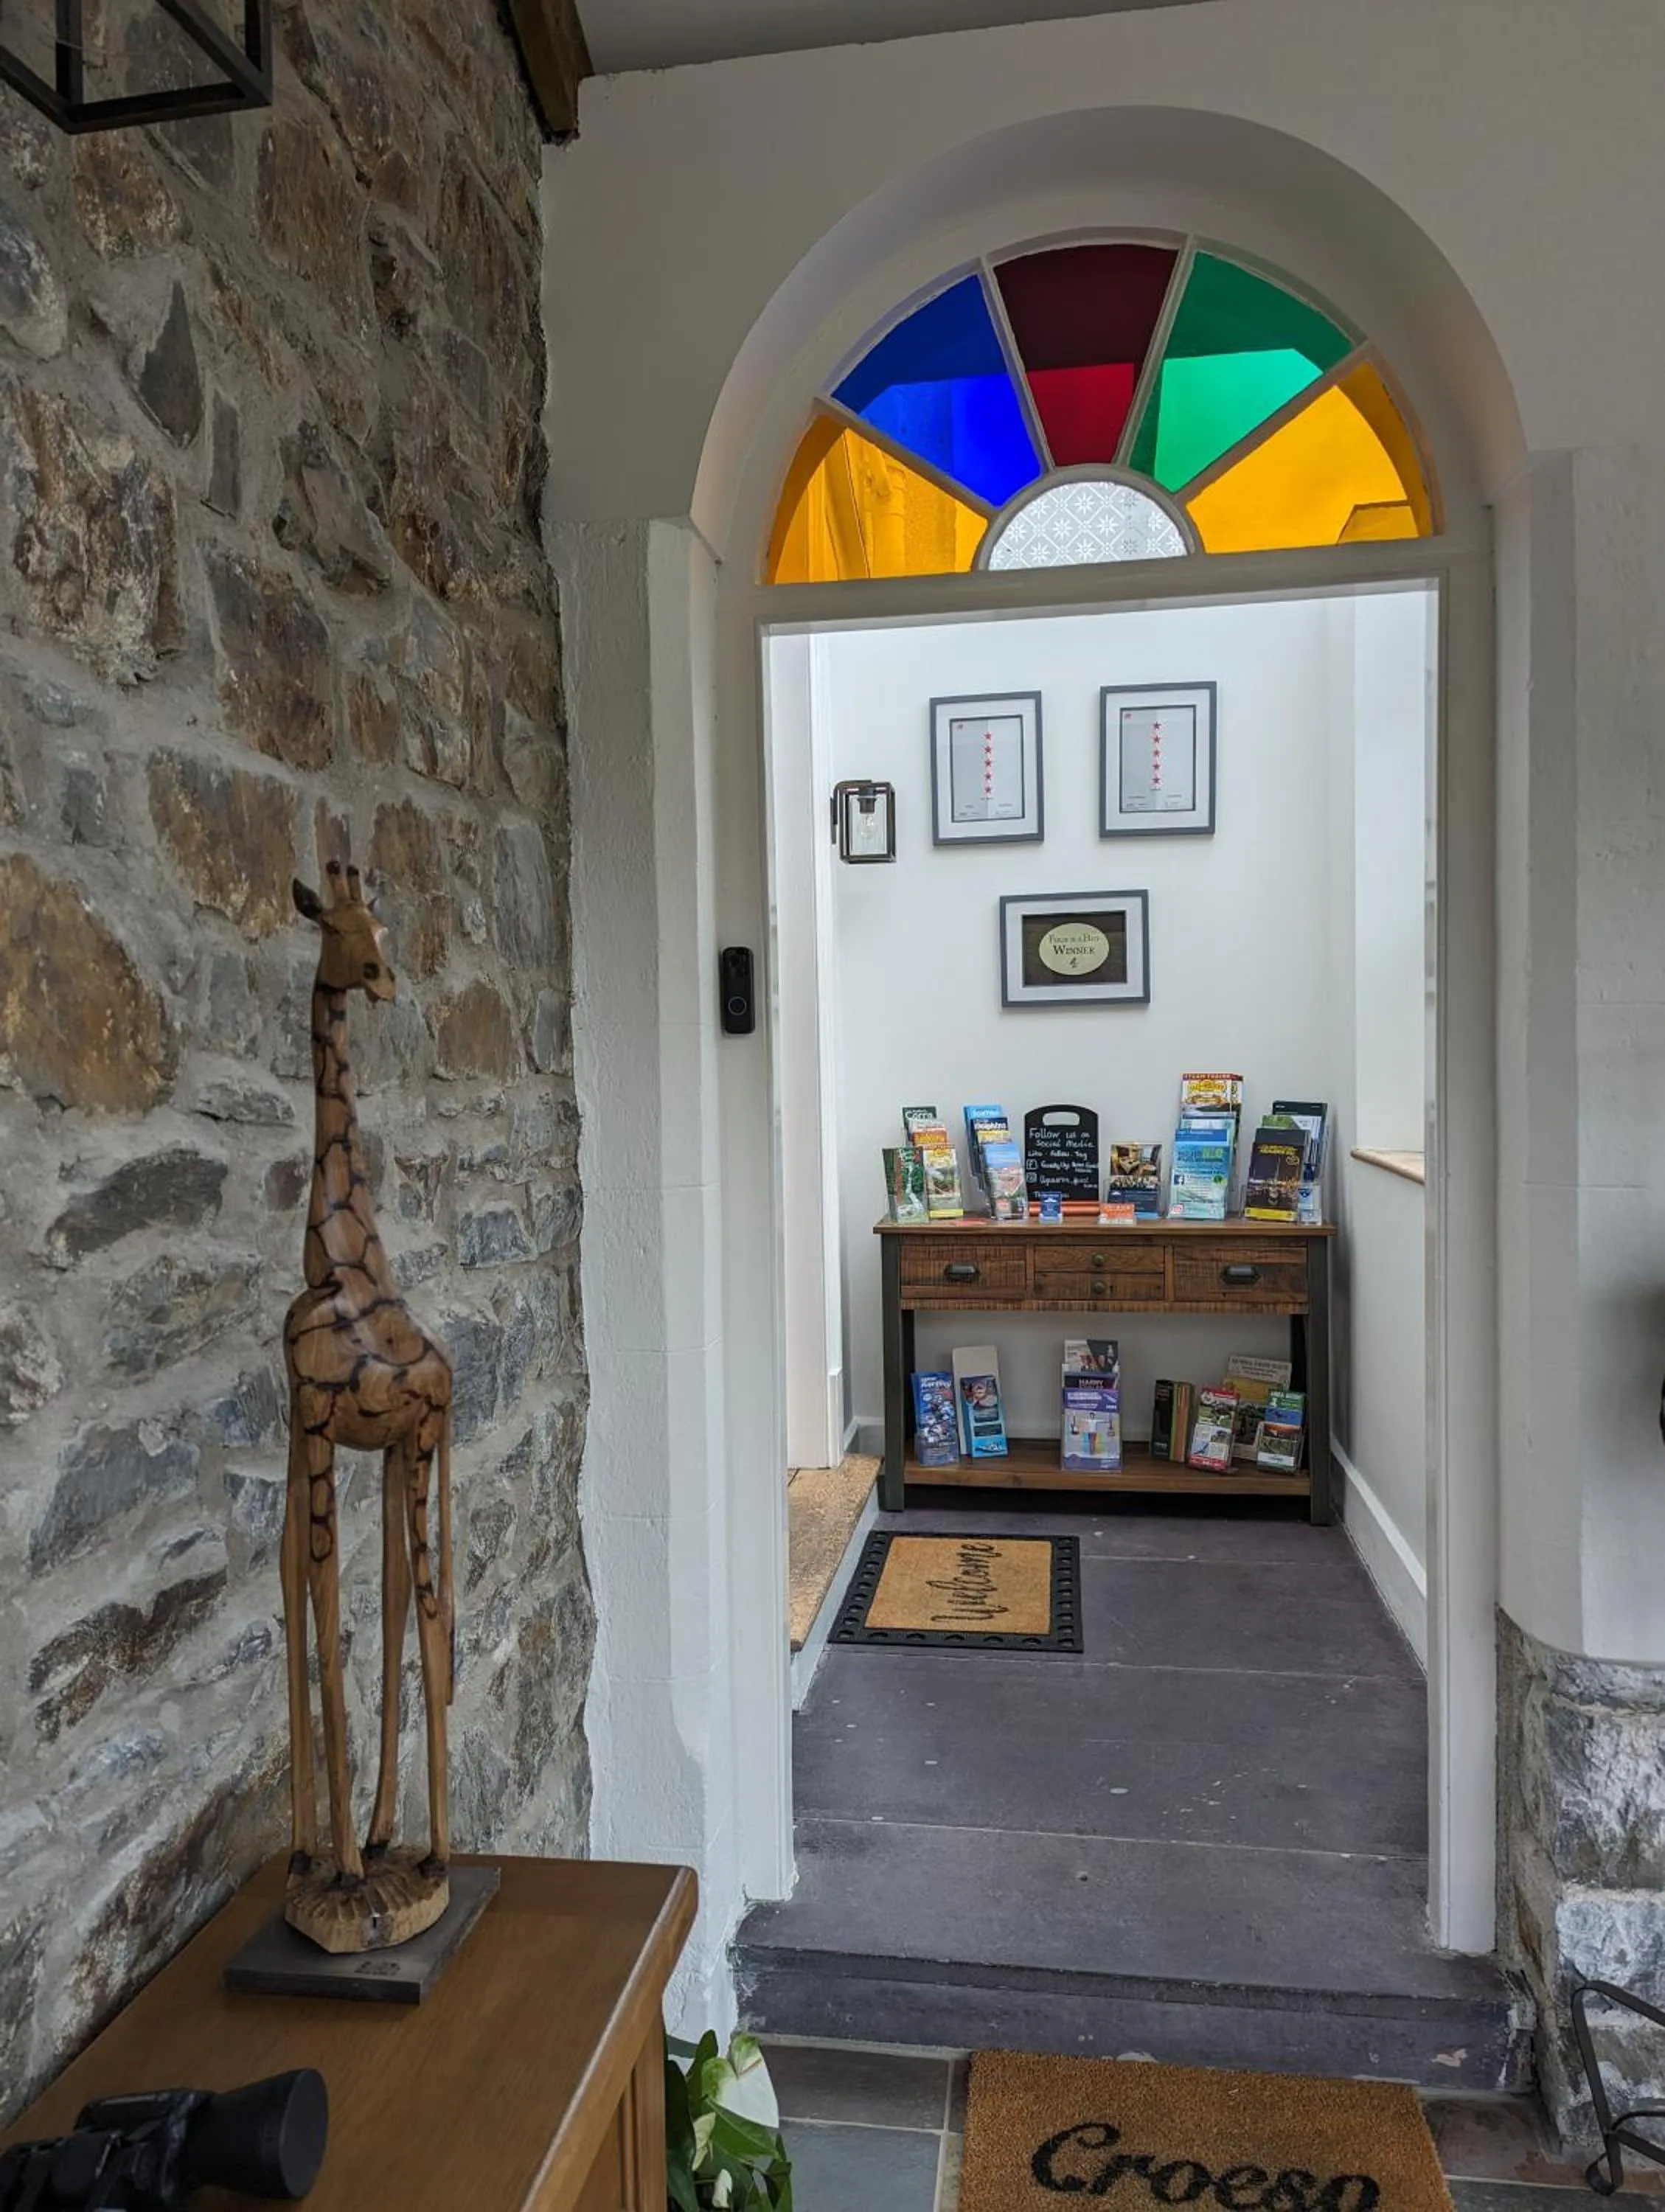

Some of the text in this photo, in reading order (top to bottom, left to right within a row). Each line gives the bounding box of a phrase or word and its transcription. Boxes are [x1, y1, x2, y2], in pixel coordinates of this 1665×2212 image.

[1053, 945, 1095, 955] WINNER
[1029, 1127, 1060, 1138] Follow
[1035, 1138, 1095, 1147] Social Media
[925, 1542, 1009, 1622] Welcome
[1032, 2122, 1381, 2212] Croeso
